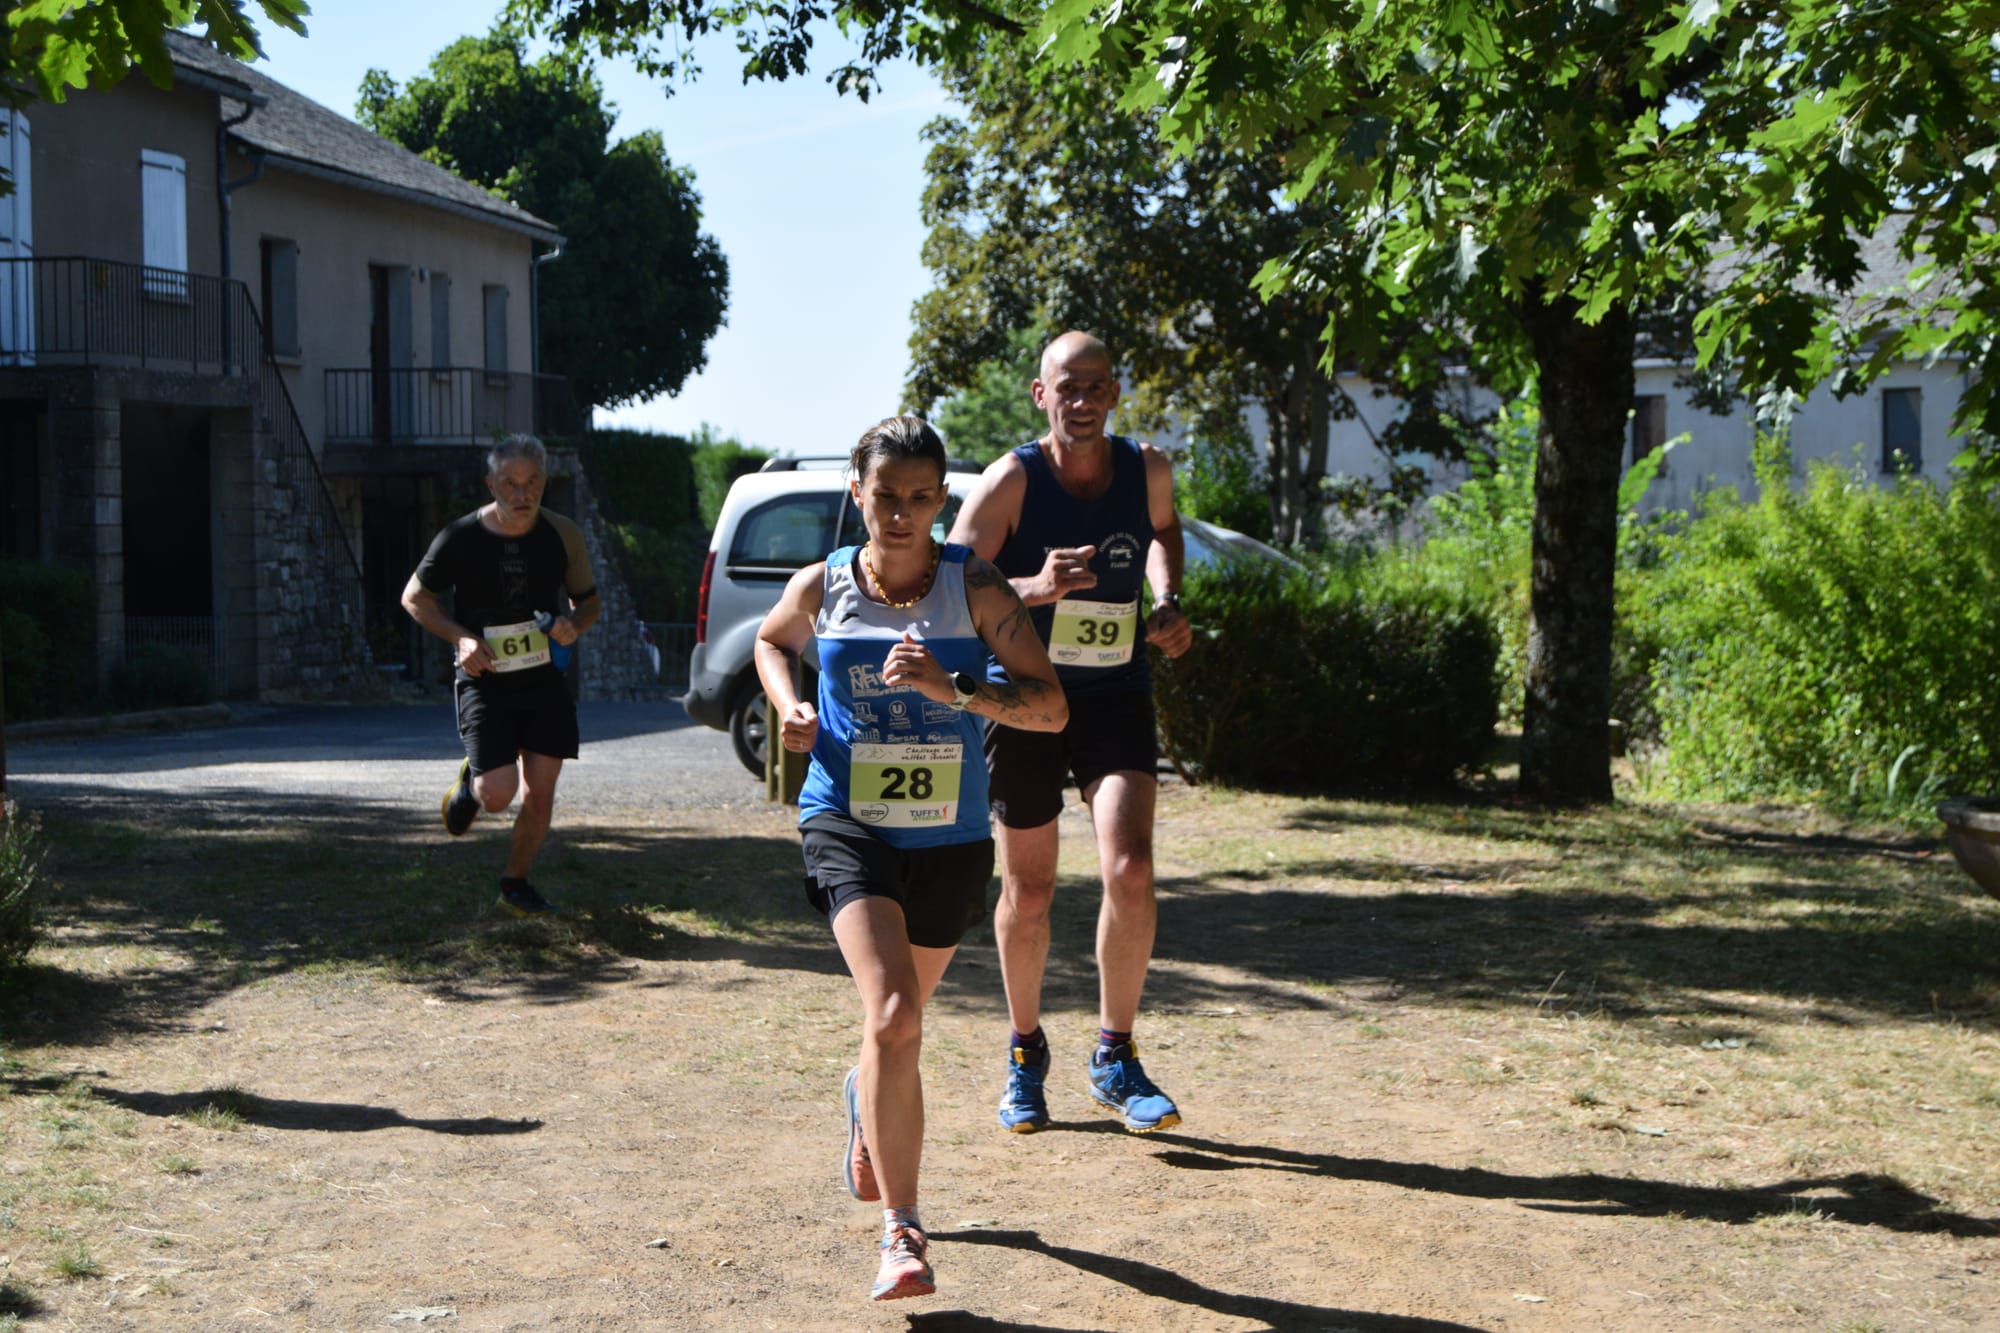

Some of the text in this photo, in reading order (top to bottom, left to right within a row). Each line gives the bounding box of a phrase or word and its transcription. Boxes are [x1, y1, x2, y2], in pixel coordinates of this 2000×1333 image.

[502, 634, 531, 656] 61
[1076, 618, 1120, 646] 39
[880, 767, 934, 800] 28
